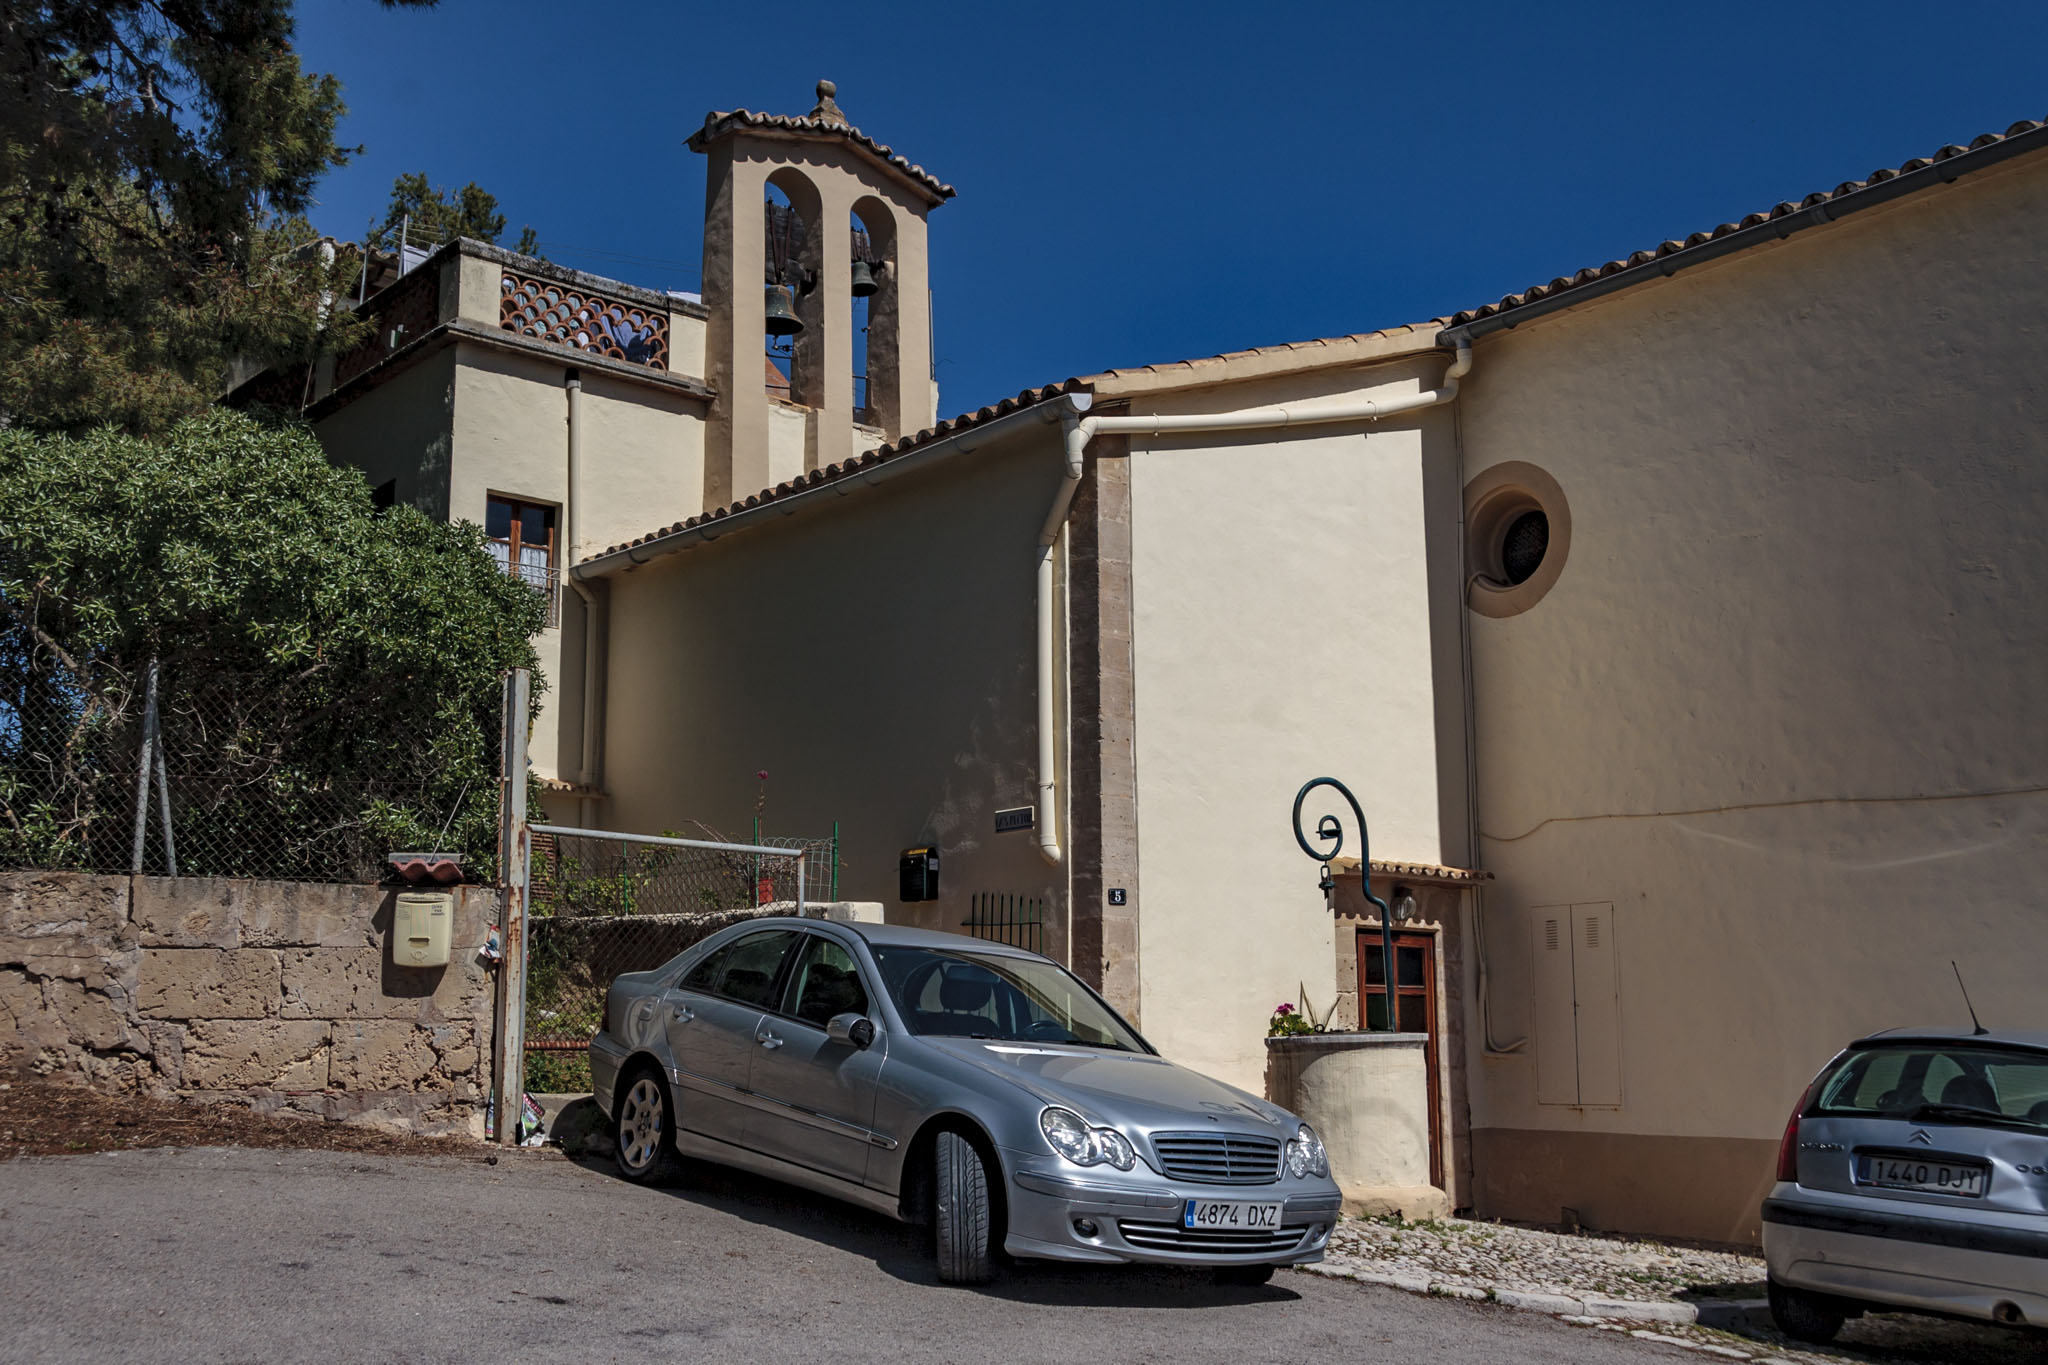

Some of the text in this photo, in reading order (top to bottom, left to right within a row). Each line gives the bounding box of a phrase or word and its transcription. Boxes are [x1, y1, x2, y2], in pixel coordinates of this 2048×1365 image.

[1115, 890, 1121, 902] 5
[1877, 1160, 1977, 1190] 1440 DJY
[1197, 1203, 1278, 1227] 4874 DXZ
